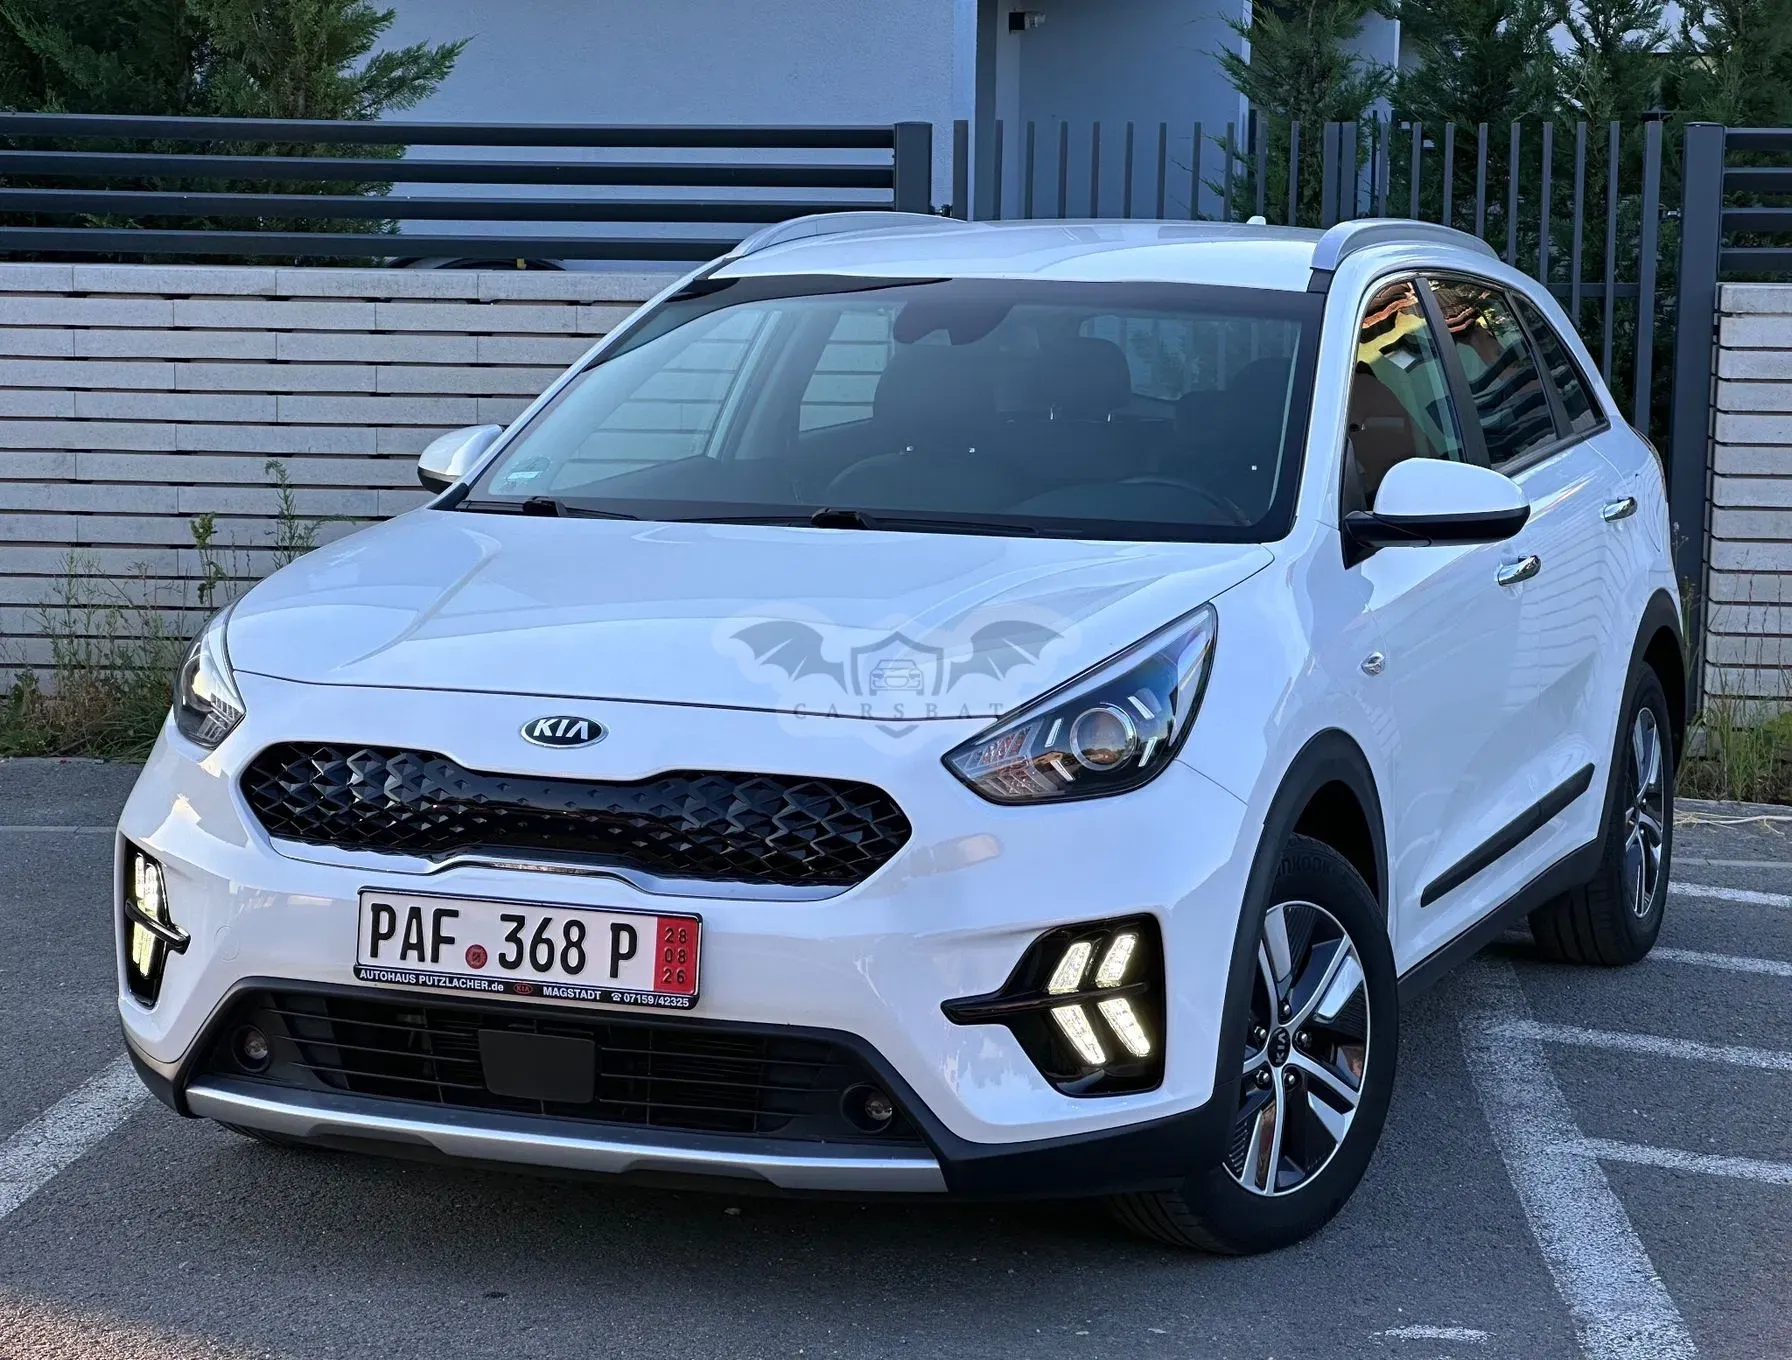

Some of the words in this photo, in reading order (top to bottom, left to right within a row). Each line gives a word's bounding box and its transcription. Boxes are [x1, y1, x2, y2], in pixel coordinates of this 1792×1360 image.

[533, 718, 588, 740] KIA
[369, 903, 459, 963] PAF
[498, 913, 587, 975] 368
[609, 922, 638, 979] P
[664, 926, 687, 944] 28
[664, 946, 687, 964] 08
[359, 969, 417, 984] AUTOHAUS
[418, 975, 504, 992] PUTZLACHER.de
[542, 986, 602, 1001] MAGSTADT
[662, 966, 685, 984] 26
[1275, 1032, 1286, 1063] KIA
